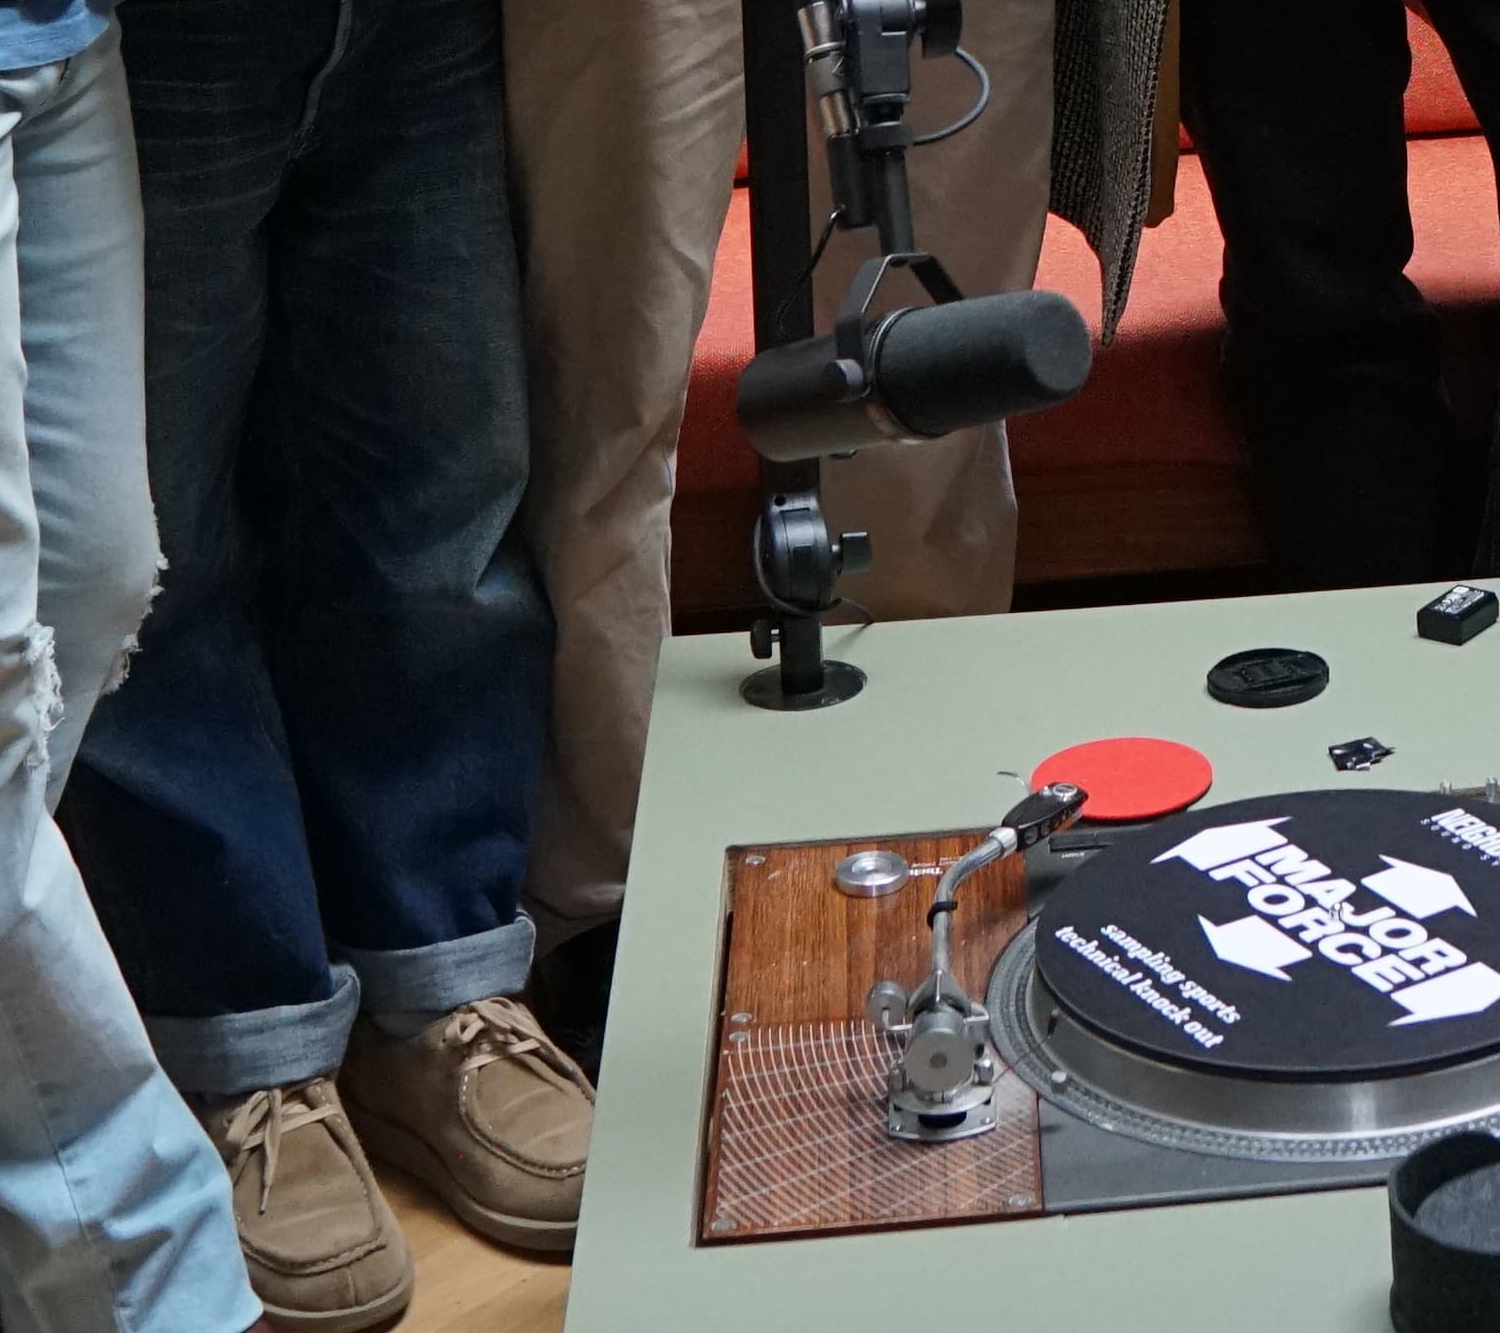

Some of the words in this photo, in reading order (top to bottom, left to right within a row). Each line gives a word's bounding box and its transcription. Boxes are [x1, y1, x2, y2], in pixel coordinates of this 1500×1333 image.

[1100, 924, 1184, 985] sampling
[1177, 973, 1242, 1025] sports
[1208, 859, 1425, 993] FORCE
[1254, 843, 1470, 985] MAJOR
[1055, 925, 1138, 985] technical
[1130, 967, 1195, 1027] knock
[1184, 1019, 1225, 1049] out
